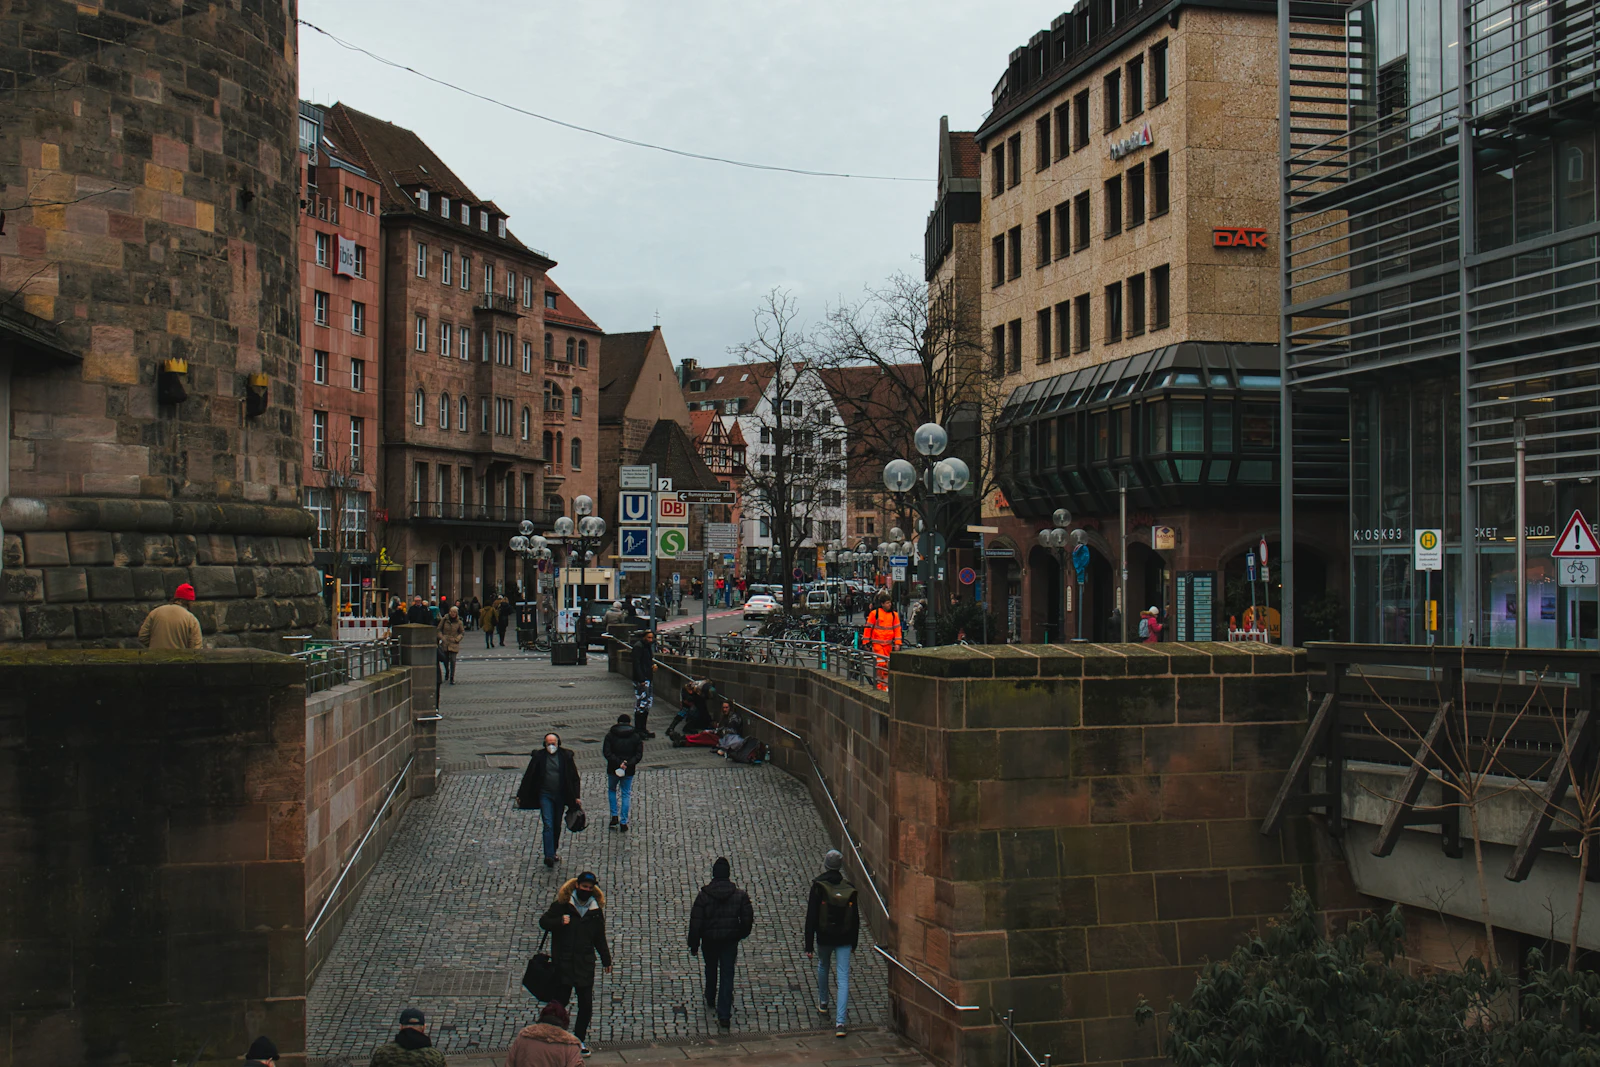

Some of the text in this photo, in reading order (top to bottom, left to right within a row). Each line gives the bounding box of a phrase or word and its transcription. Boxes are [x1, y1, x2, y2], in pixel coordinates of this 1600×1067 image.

[1214, 227, 1268, 247] DAK
[339, 246, 353, 266] ibis
[662, 480, 669, 490] 2
[626, 496, 645, 518] U
[664, 502, 683, 514] DB
[1524, 526, 1550, 536] SHOP
[666, 533, 679, 552] S
[1424, 535, 1433, 546] H
